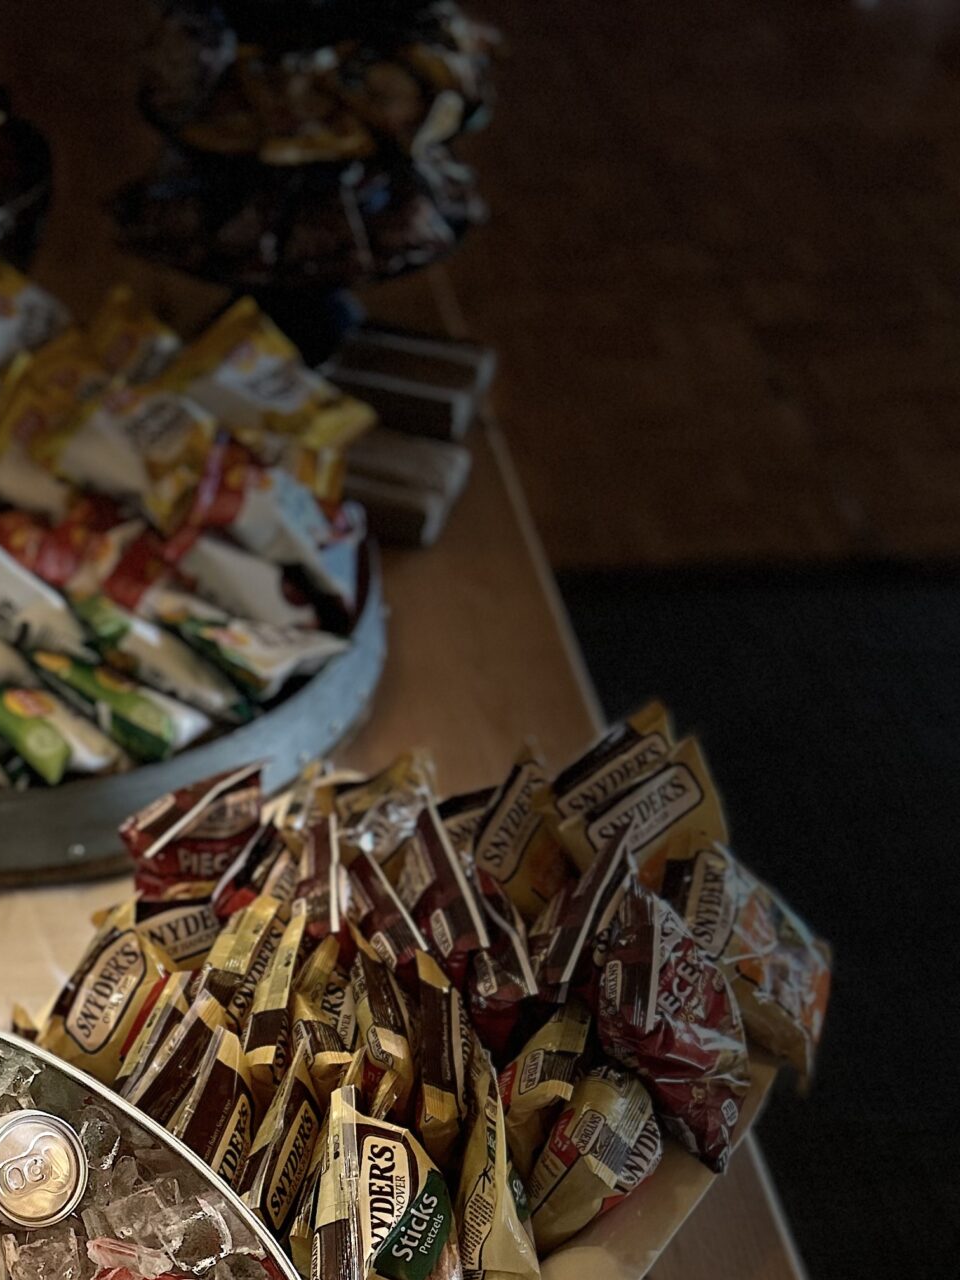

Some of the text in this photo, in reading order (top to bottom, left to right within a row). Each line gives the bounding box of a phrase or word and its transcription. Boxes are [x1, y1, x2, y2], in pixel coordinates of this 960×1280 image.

[177, 846, 234, 877] PIEC
[149, 913, 216, 946] NYDE
[76, 943, 140, 1039] SNYDER'S
[216, 1102, 250, 1186] YDER'S
[577, 1112, 602, 1154] SNYDER'S
[270, 1108, 314, 1217] SNYDER'S
[391, 1192, 439, 1263] Sticks
[419, 1213, 444, 1255] Pretzels
